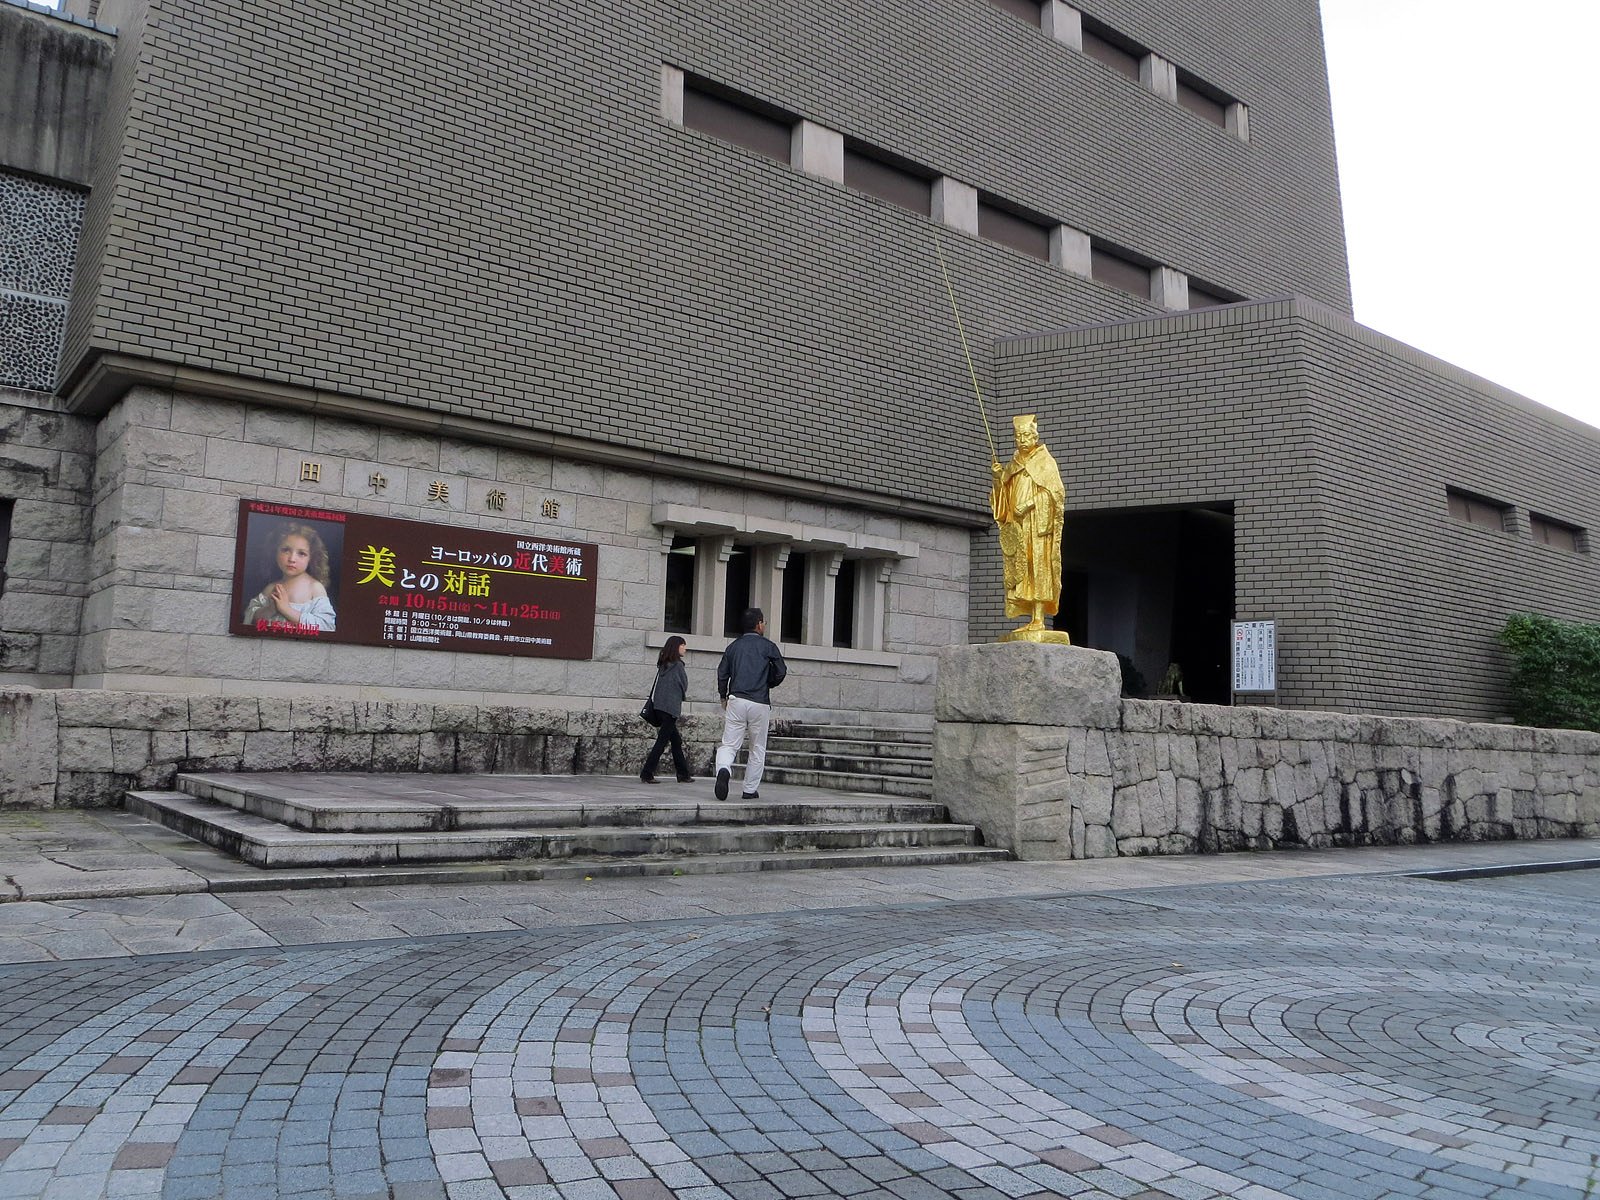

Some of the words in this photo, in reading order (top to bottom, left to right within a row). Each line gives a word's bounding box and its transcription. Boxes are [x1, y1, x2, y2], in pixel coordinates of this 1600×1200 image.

[300, 460, 561, 519] 田中美術館
[430, 545, 583, 576] ヨーロッパの近代美術
[516, 540, 582, 556] 国立西洋美術館所蔵
[356, 544, 491, 597] 美との対話
